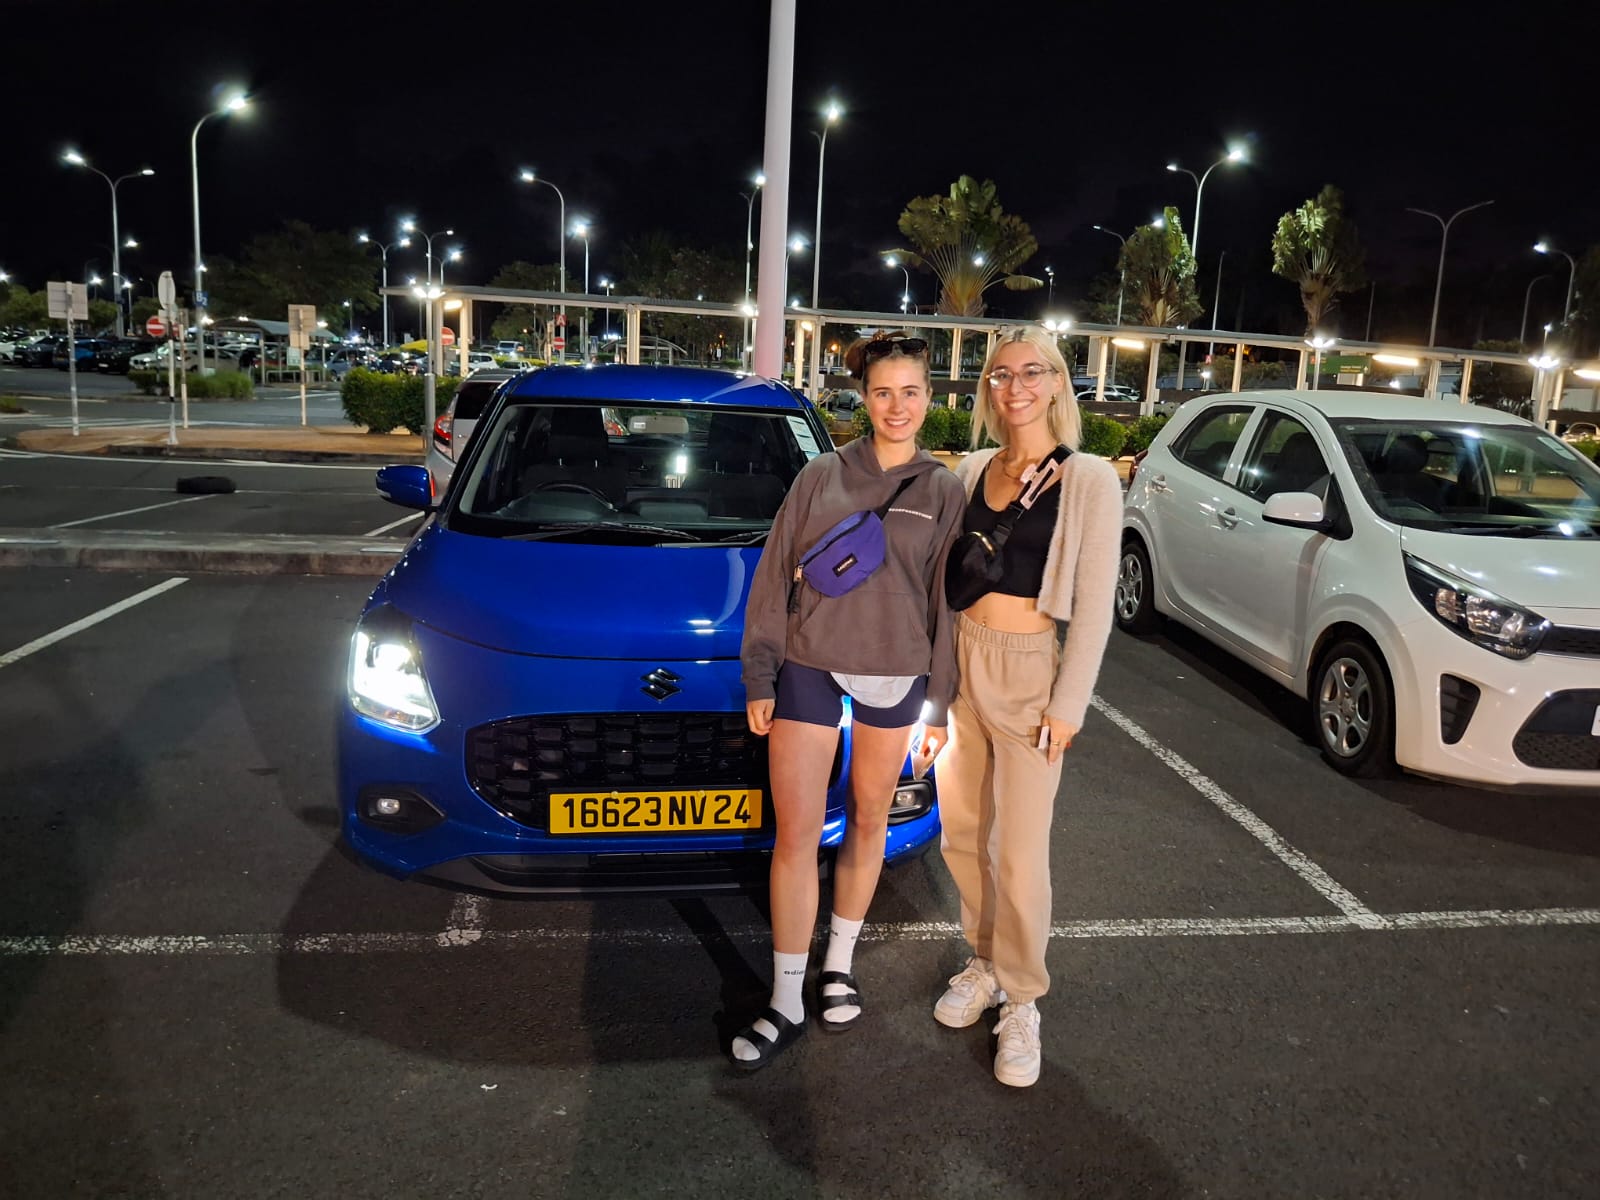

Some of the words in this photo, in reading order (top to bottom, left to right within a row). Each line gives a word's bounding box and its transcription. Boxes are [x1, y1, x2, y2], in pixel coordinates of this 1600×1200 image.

[556, 315, 566, 326] A
[563, 797, 661, 828] 16623
[669, 796, 707, 826] NV
[714, 794, 751, 824] 24
